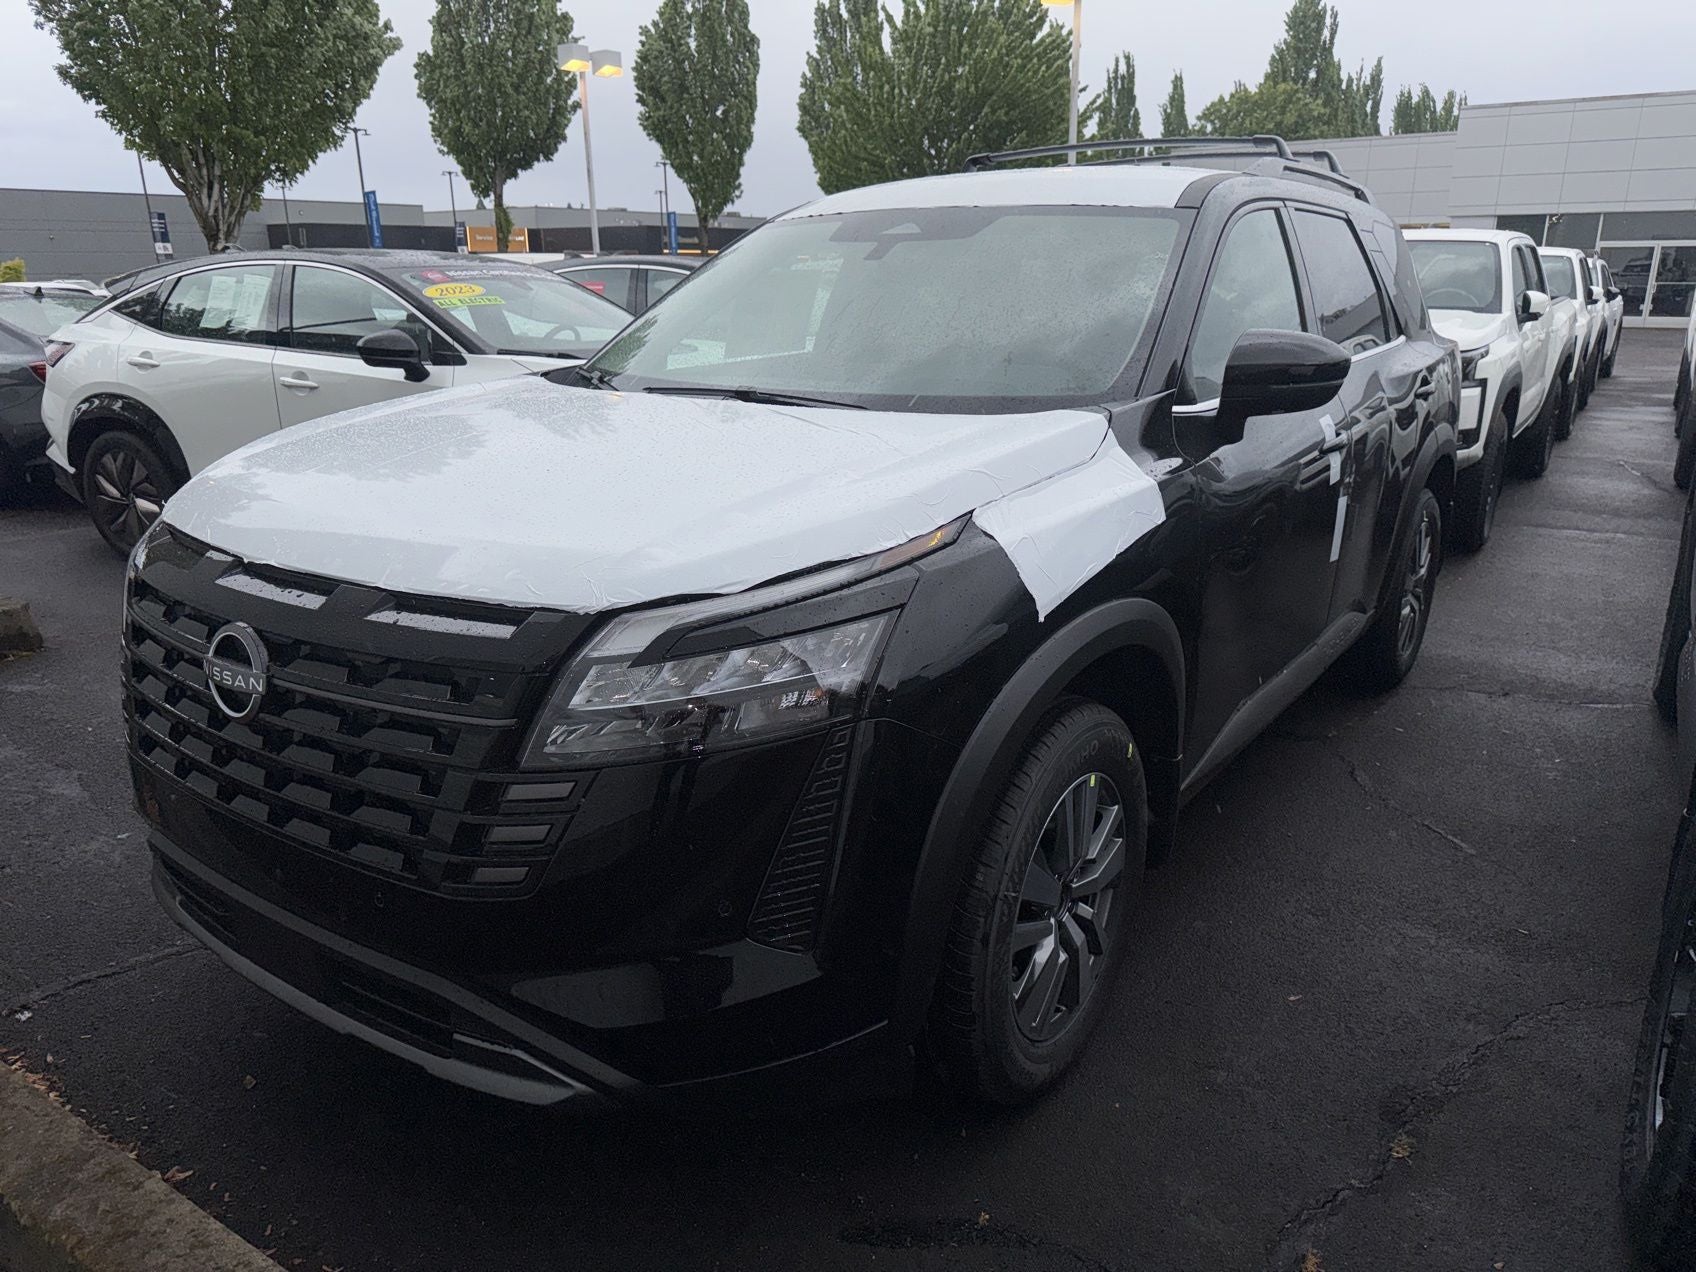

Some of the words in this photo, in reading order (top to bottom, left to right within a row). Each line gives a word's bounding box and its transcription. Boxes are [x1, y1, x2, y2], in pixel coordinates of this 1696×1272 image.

[435, 285, 476, 297] 2023
[438, 299, 457, 307] ALL
[459, 296, 501, 305] ELECTRIC
[203, 659, 263, 692] NISSAN
